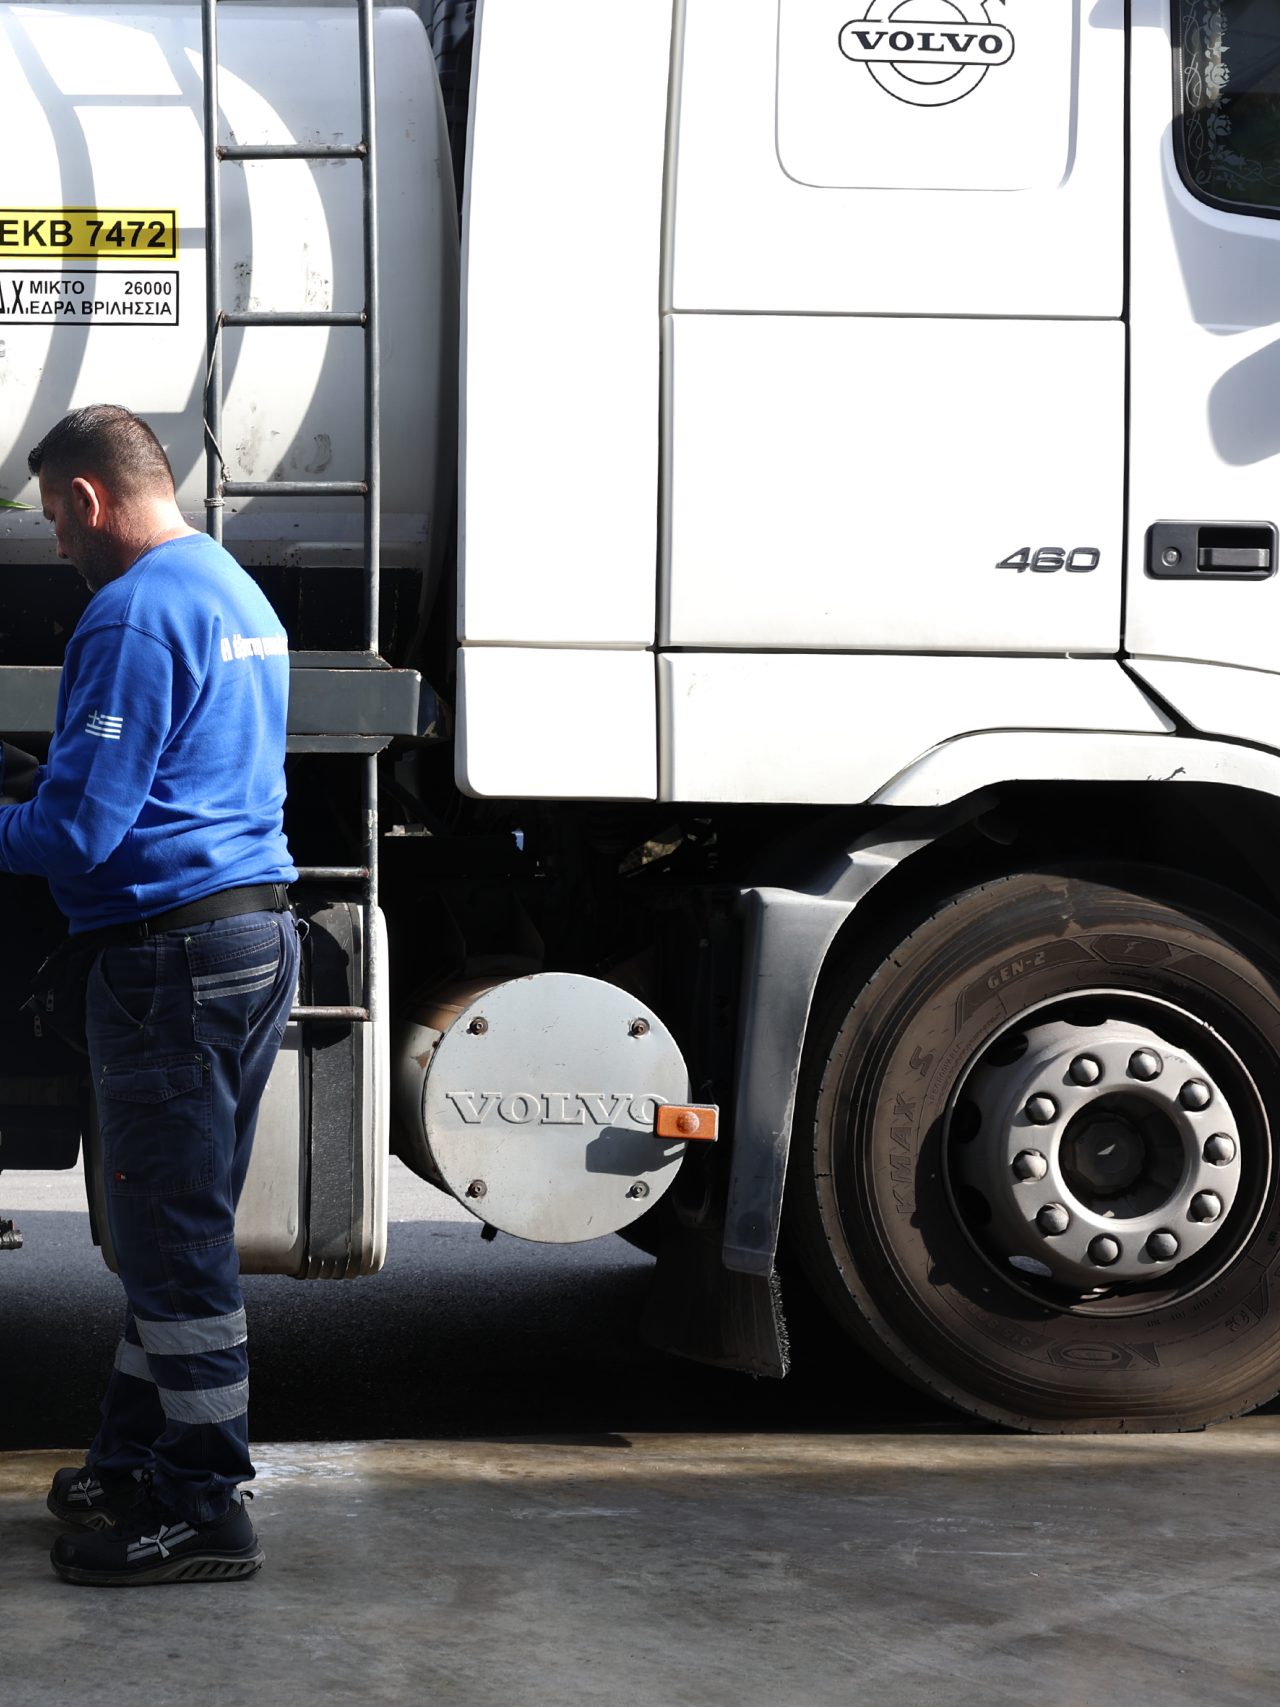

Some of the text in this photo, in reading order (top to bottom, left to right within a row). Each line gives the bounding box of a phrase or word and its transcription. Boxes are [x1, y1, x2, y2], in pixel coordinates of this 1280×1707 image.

[851, 31, 1003, 54] VOLVO
[86, 220, 166, 248] 7472
[29, 280, 172, 296] ΜΙΚΤΟ 26000
[30, 301, 172, 316] ΕΔΡΑ ΒΡΙΛΗΣΣΙΑ
[994, 547, 1101, 573] 460
[987, 951, 1046, 990] GEN-2
[889, 1091, 917, 1213] KMAX
